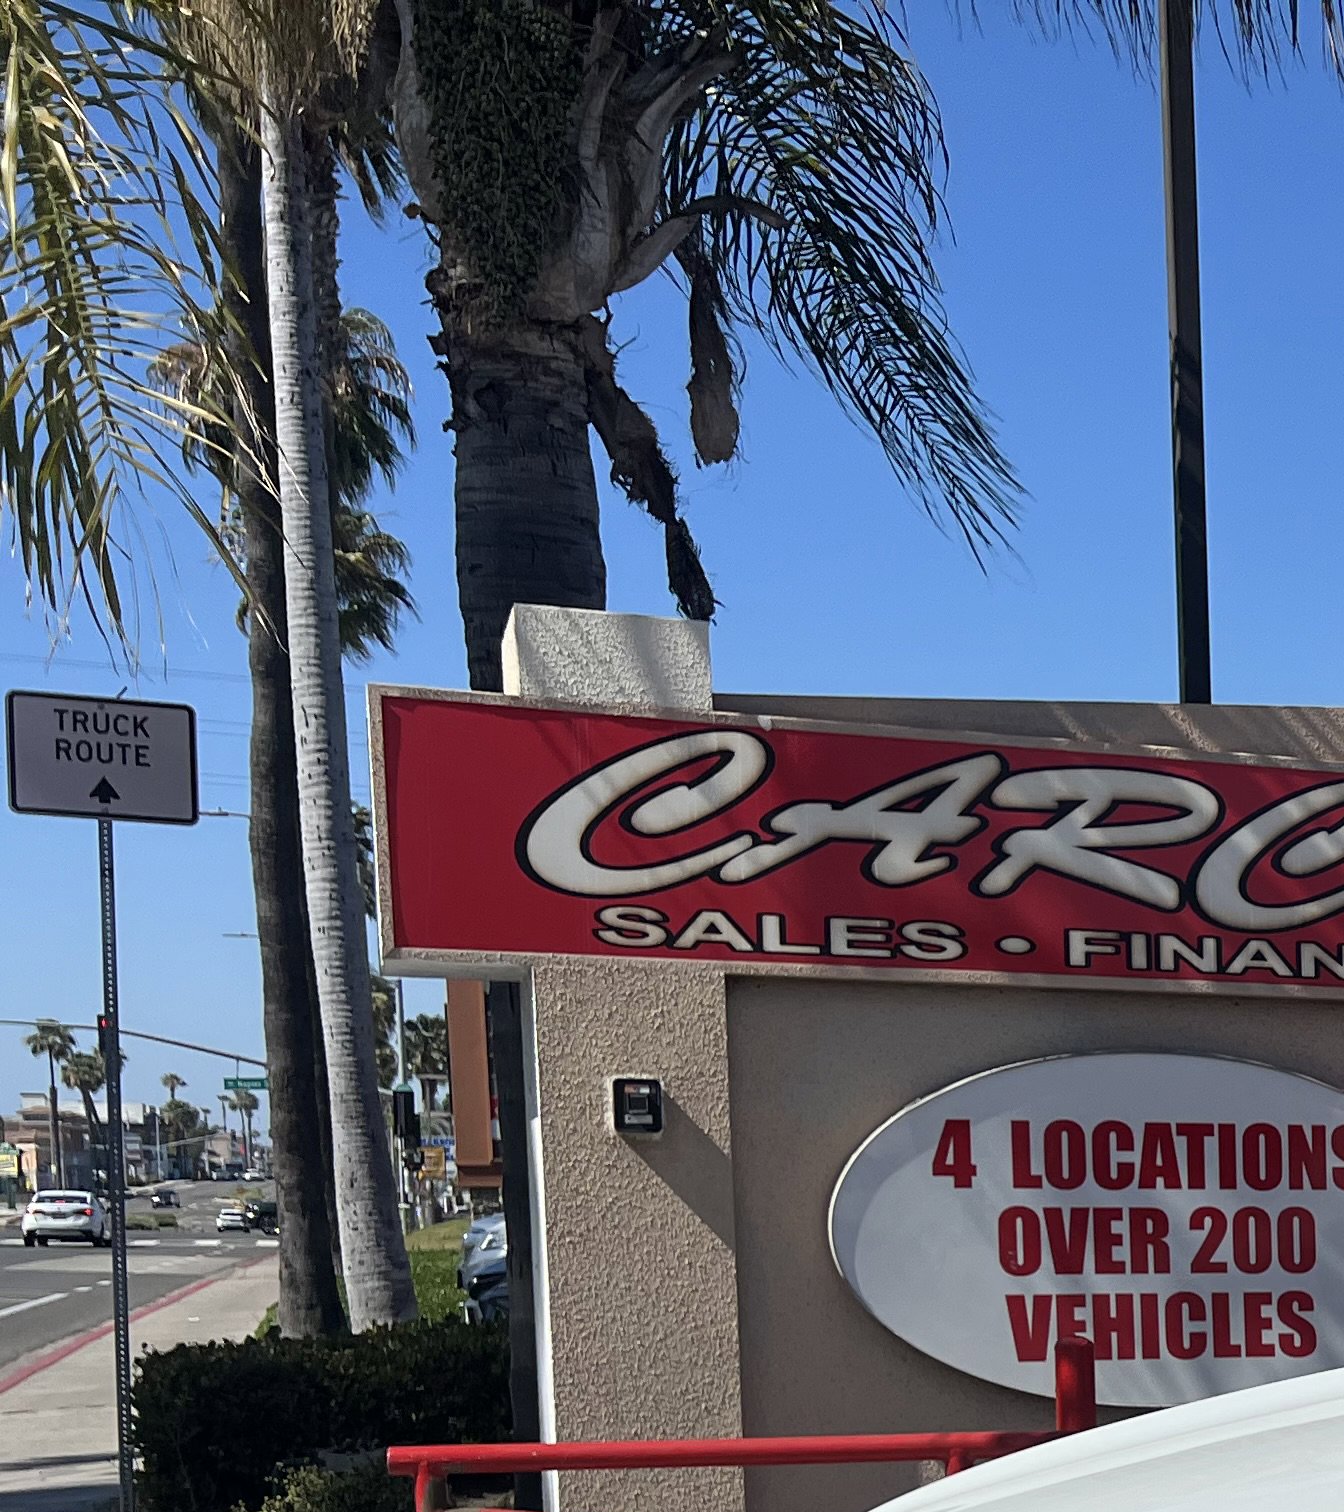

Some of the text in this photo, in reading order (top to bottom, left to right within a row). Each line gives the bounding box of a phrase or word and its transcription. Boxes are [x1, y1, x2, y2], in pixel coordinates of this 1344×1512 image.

[53, 708, 150, 738] TRUCK
[55, 738, 151, 767] ROUTE
[594, 905, 970, 964] SALES
[932, 1119, 977, 1189] 4
[999, 1205, 1317, 1276] OVER 200
[1005, 1290, 1318, 1362] VEHICLES
